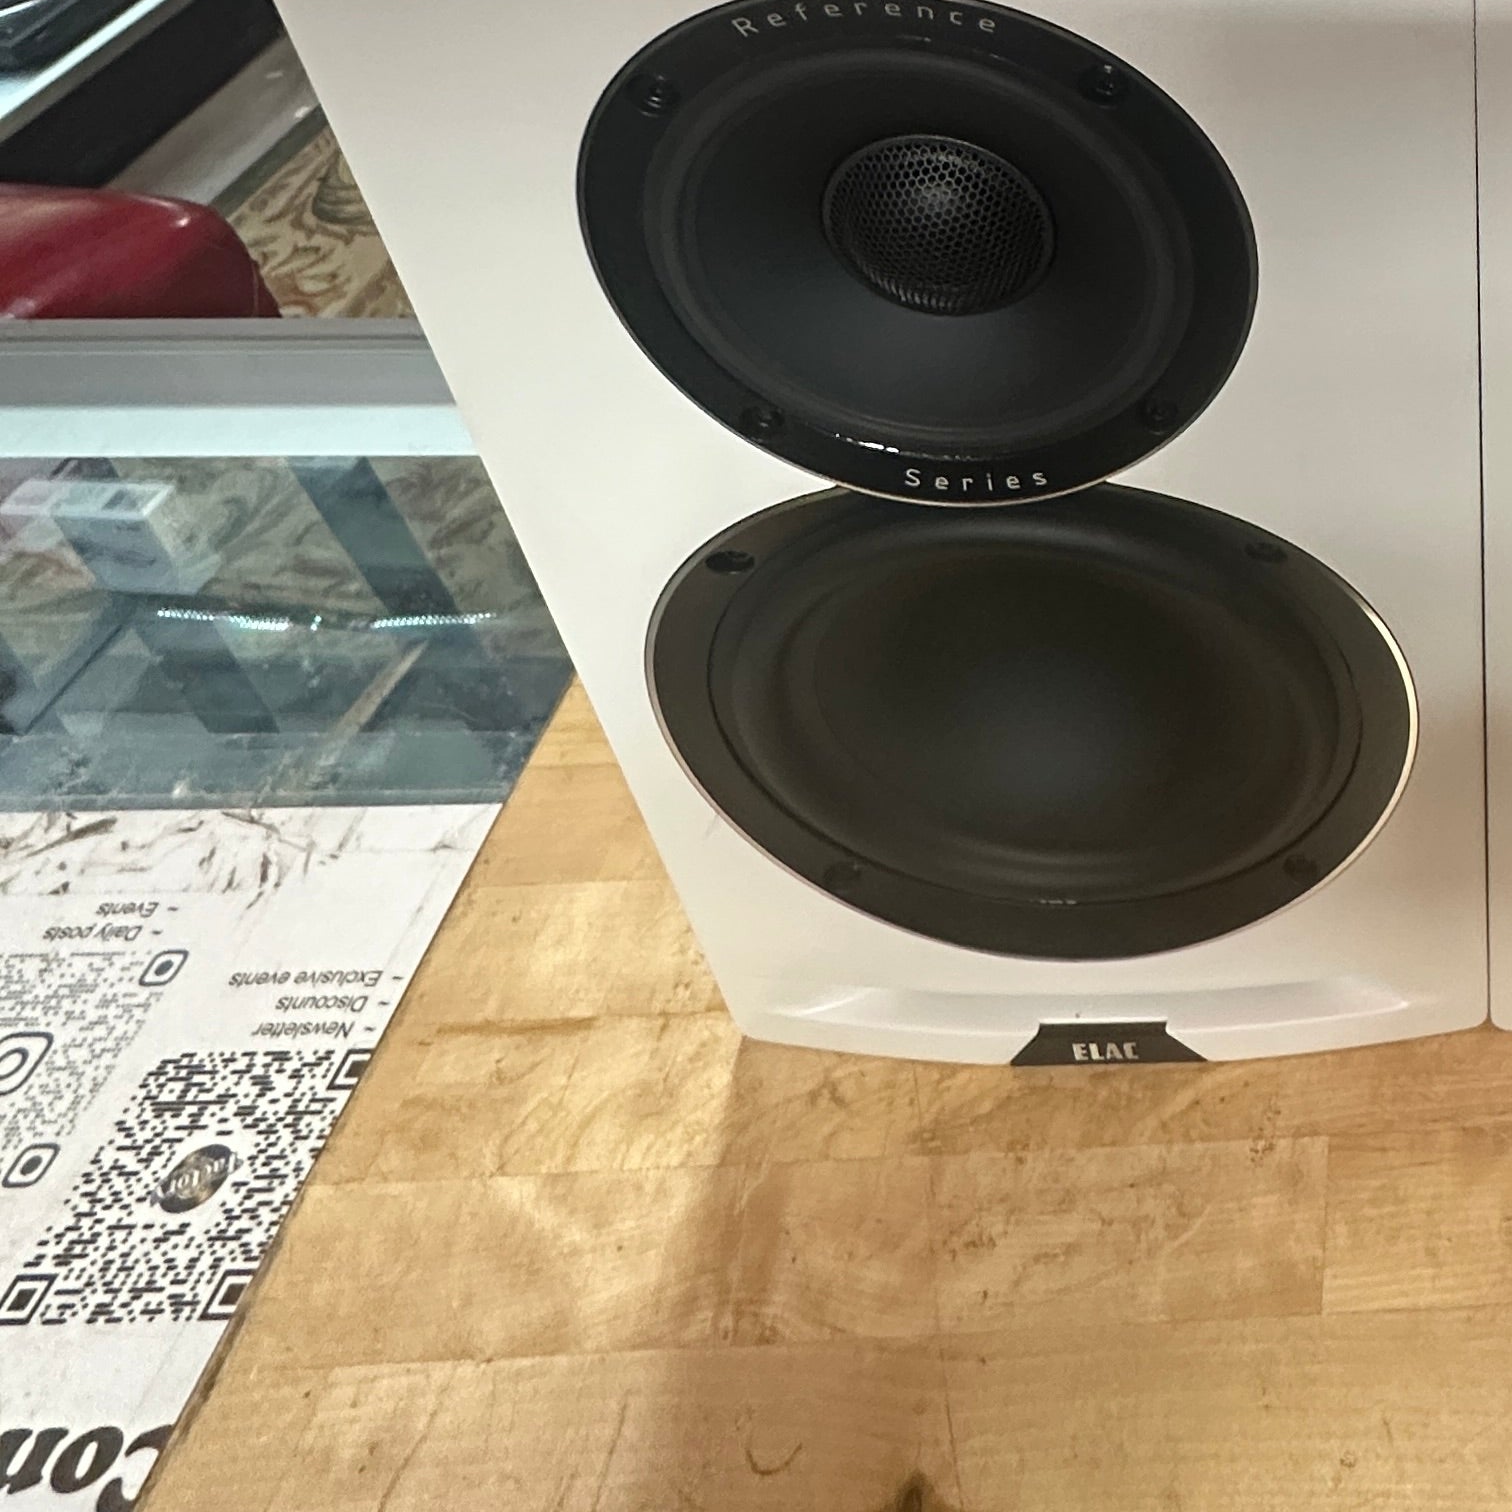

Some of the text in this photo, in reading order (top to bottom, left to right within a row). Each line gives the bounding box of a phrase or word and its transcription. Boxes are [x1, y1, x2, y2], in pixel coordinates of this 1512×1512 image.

[731, 1, 996, 38] Reference
[904, 468, 1048, 491] Series
[96, 901, 159, 918] Events
[42, 924, 143, 942] Daily posts
[228, 969, 382, 987] Exclusive events
[275, 995, 368, 1013] Discounts
[251, 1020, 355, 1039] Newsletter
[1071, 1041, 1140, 1061] ELAC
